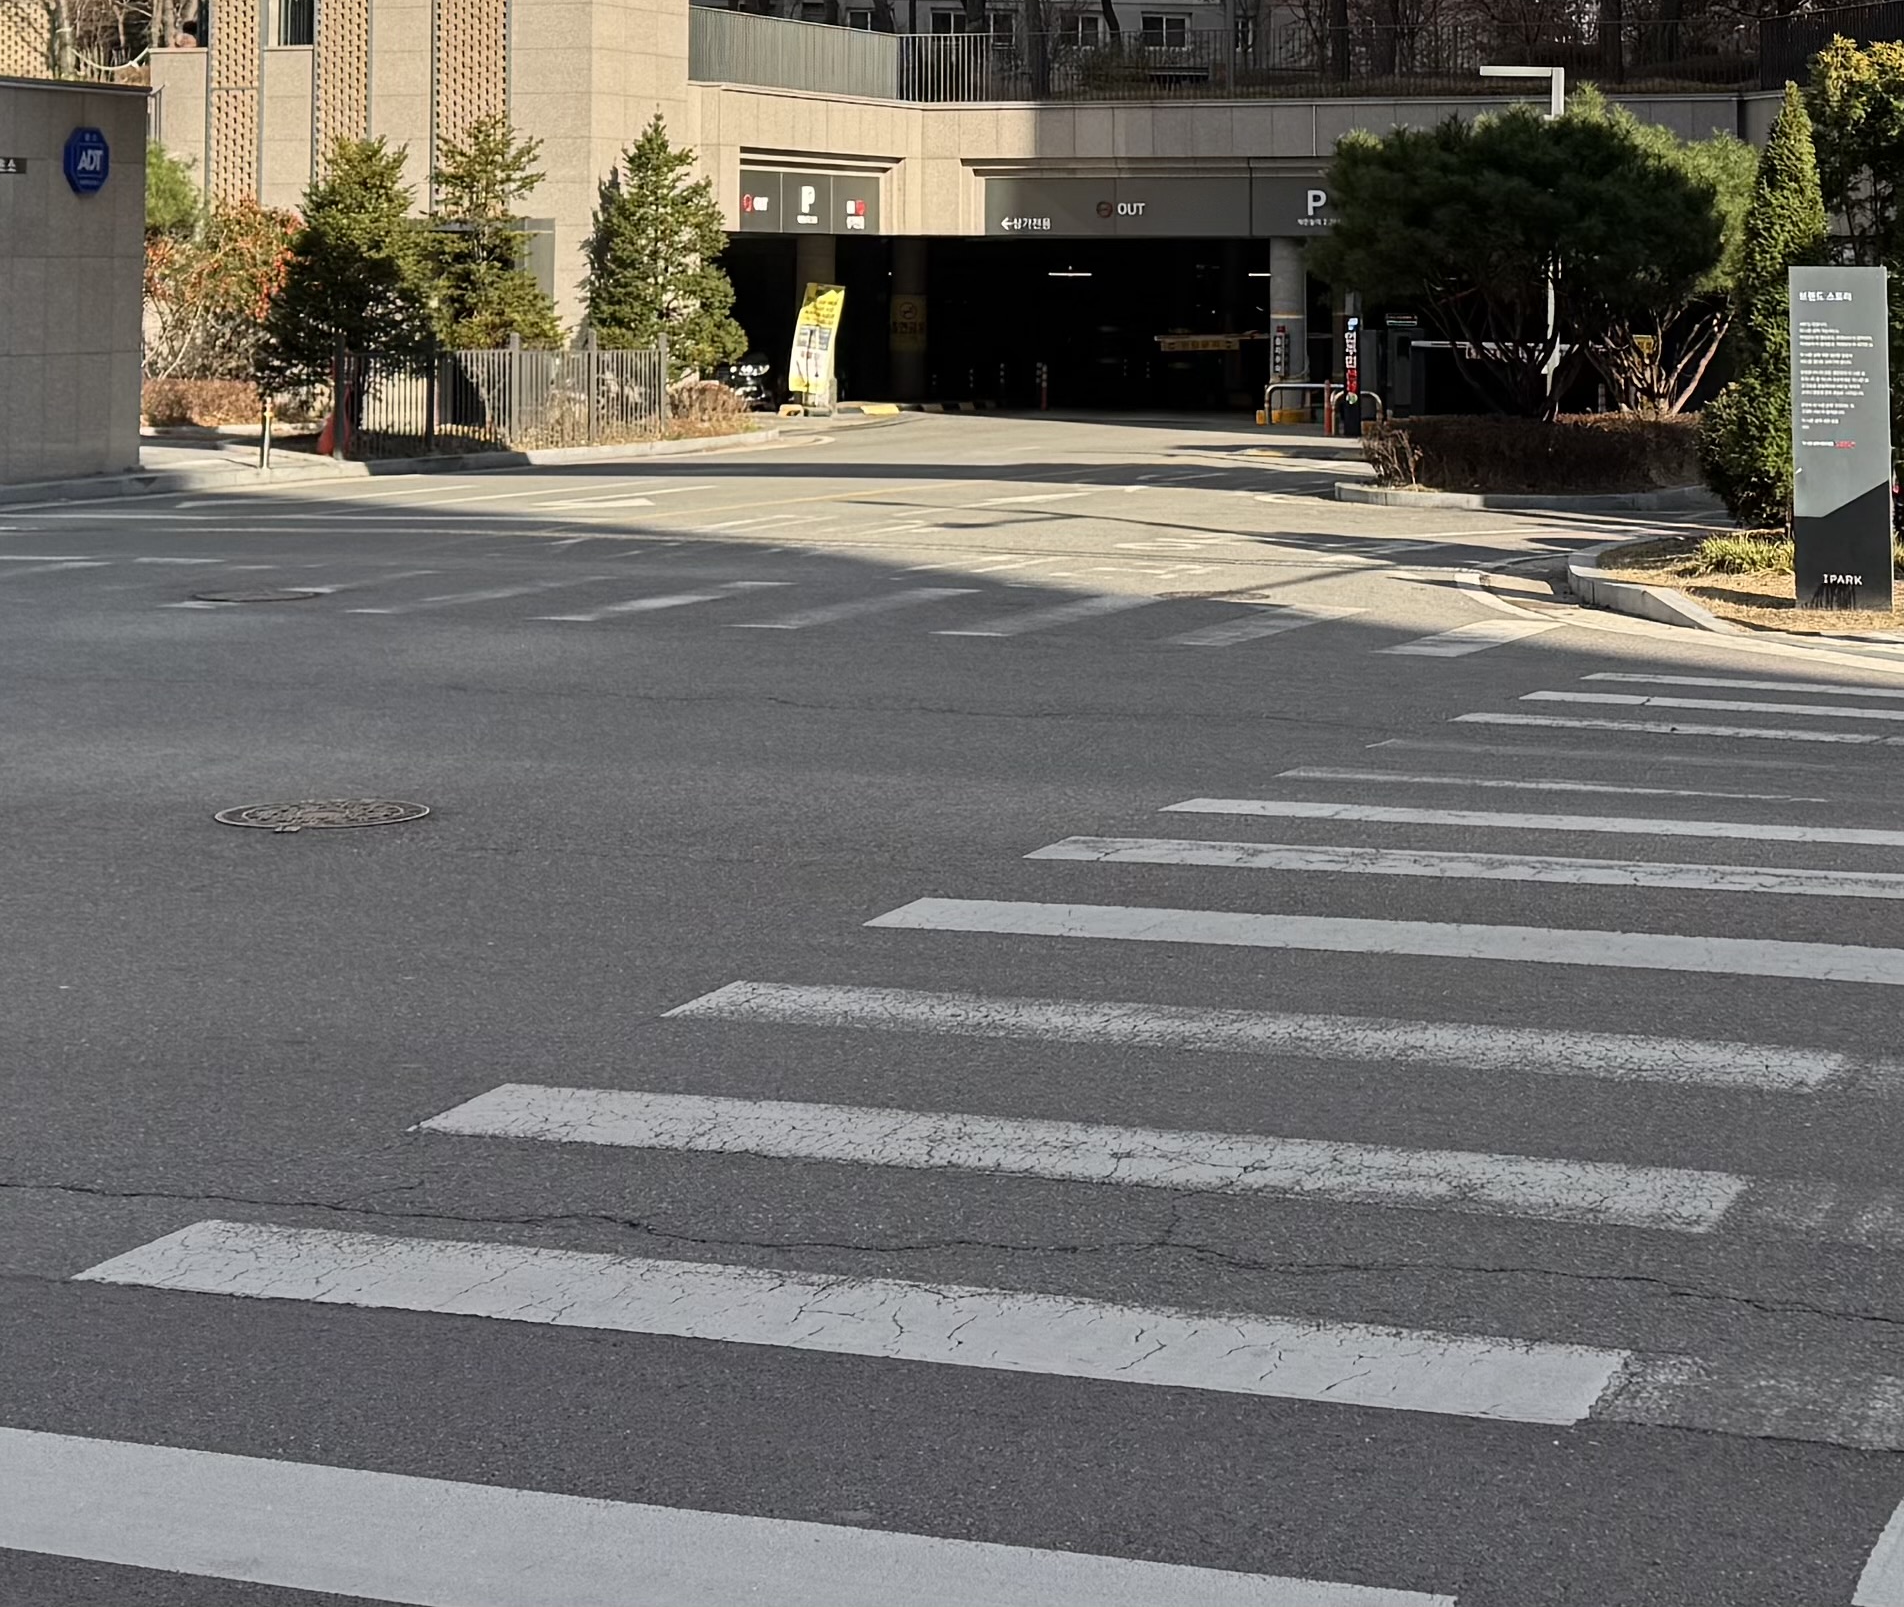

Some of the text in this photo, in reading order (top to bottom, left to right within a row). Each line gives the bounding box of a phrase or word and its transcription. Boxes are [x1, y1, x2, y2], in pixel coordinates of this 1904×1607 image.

[77, 149, 104, 172] ADT
[800, 185, 816, 214] P
[1117, 202, 1146, 216] OUT
[1307, 189, 1327, 216] P
[1823, 573, 1863, 586] IPARK
